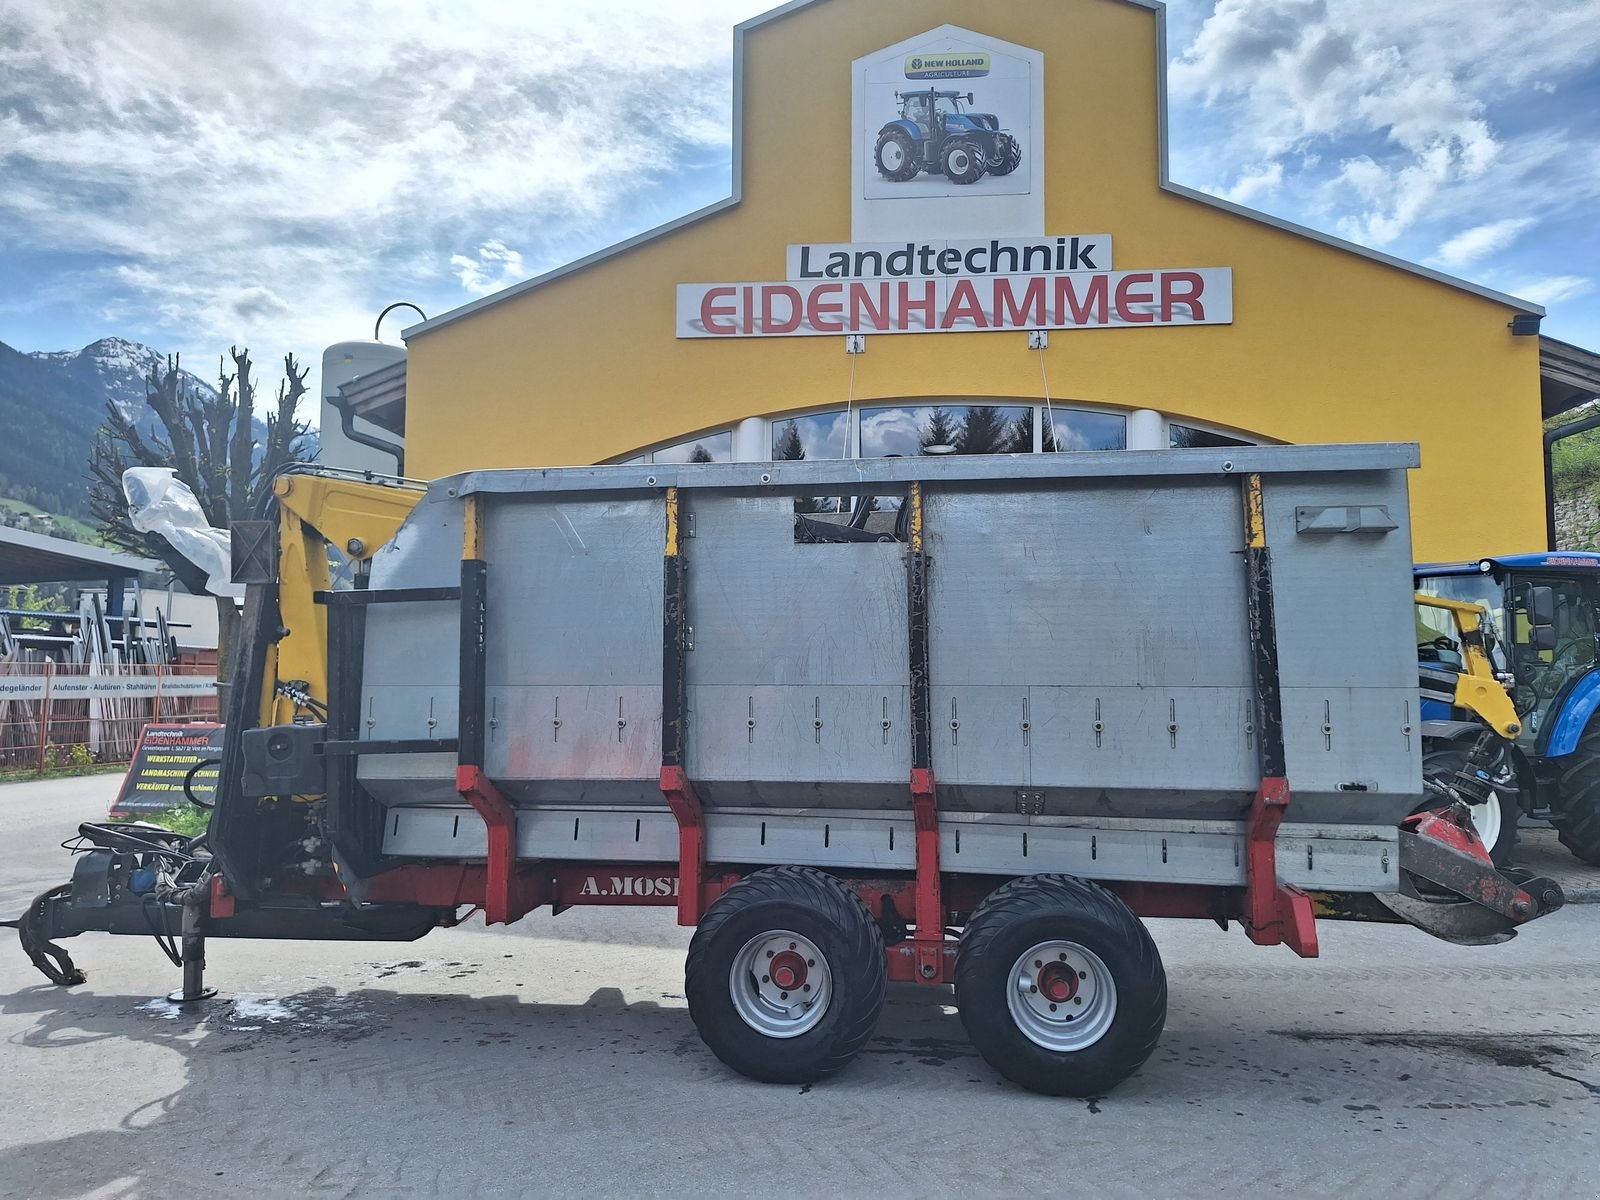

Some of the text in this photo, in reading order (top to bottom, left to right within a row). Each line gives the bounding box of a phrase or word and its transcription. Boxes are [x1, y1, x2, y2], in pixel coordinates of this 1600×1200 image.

[945, 58, 985, 67] HOLLAND
[924, 70, 970, 78] AGRICULTURE
[799, 237, 1098, 279] Landtechnik
[700, 271, 1206, 335] EIDENHAMMER
[53, 683, 88, 691] Alufenster
[94, 683, 121, 691] Alutüren
[126, 682, 157, 691] Stahltüren
[144, 737, 209, 745] EIDENHAMMER
[147, 755, 198, 763] WERKSTATTLEITER
[136, 782, 170, 791] VERKÄUFER
